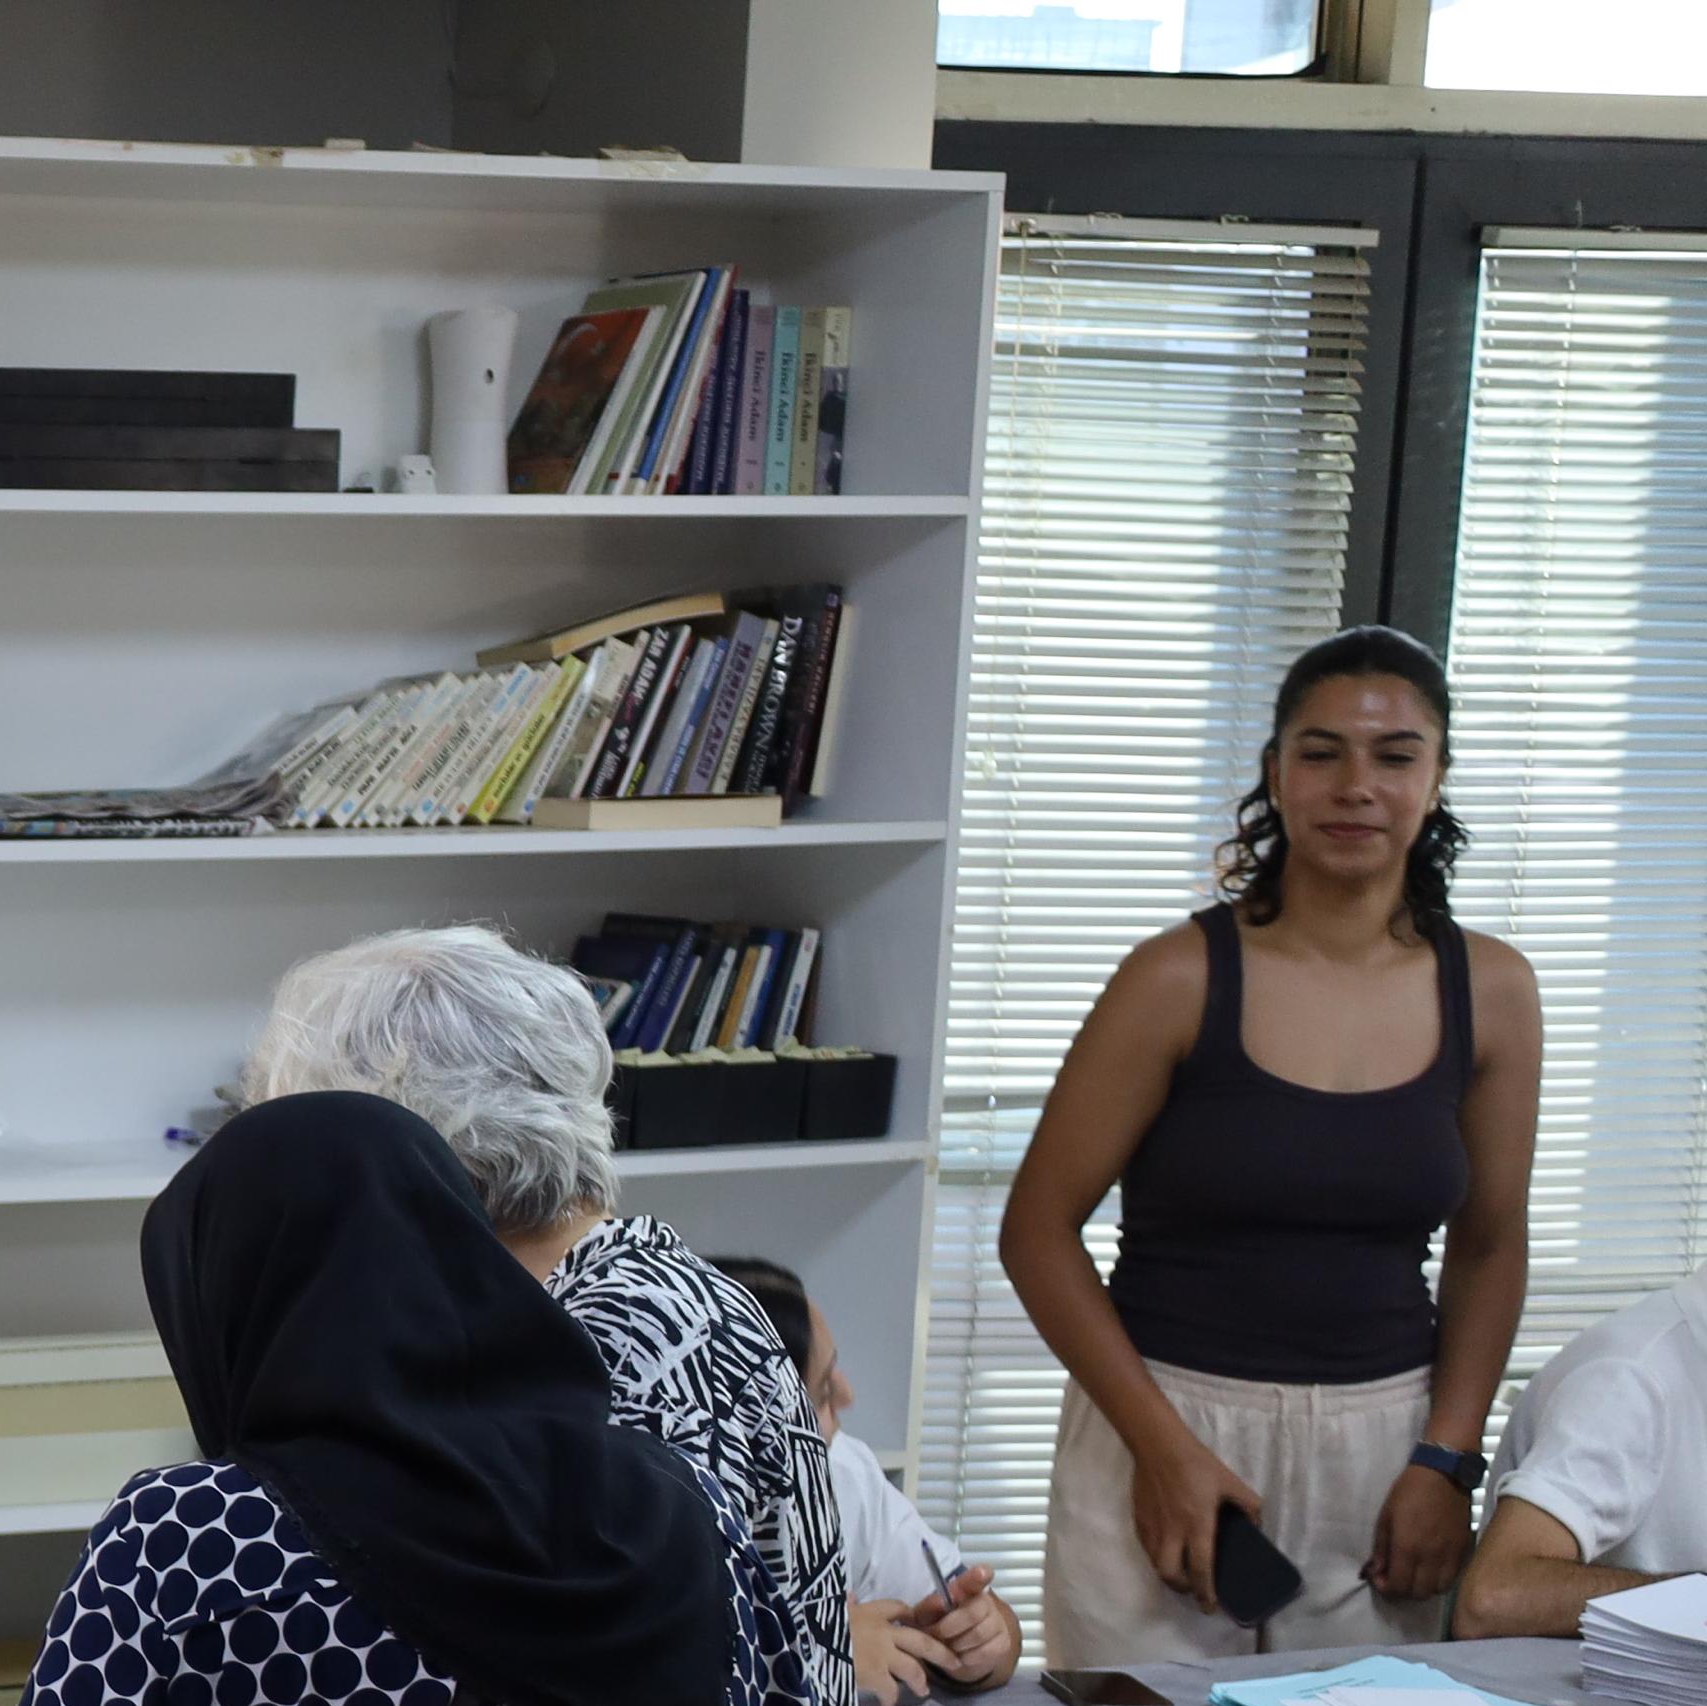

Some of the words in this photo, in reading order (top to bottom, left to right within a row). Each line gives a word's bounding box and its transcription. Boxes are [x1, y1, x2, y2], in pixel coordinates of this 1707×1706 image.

[772, 612, 803, 667] DAN
[629, 656, 658, 701] ADAM
[751, 666, 789, 749] BROWN
